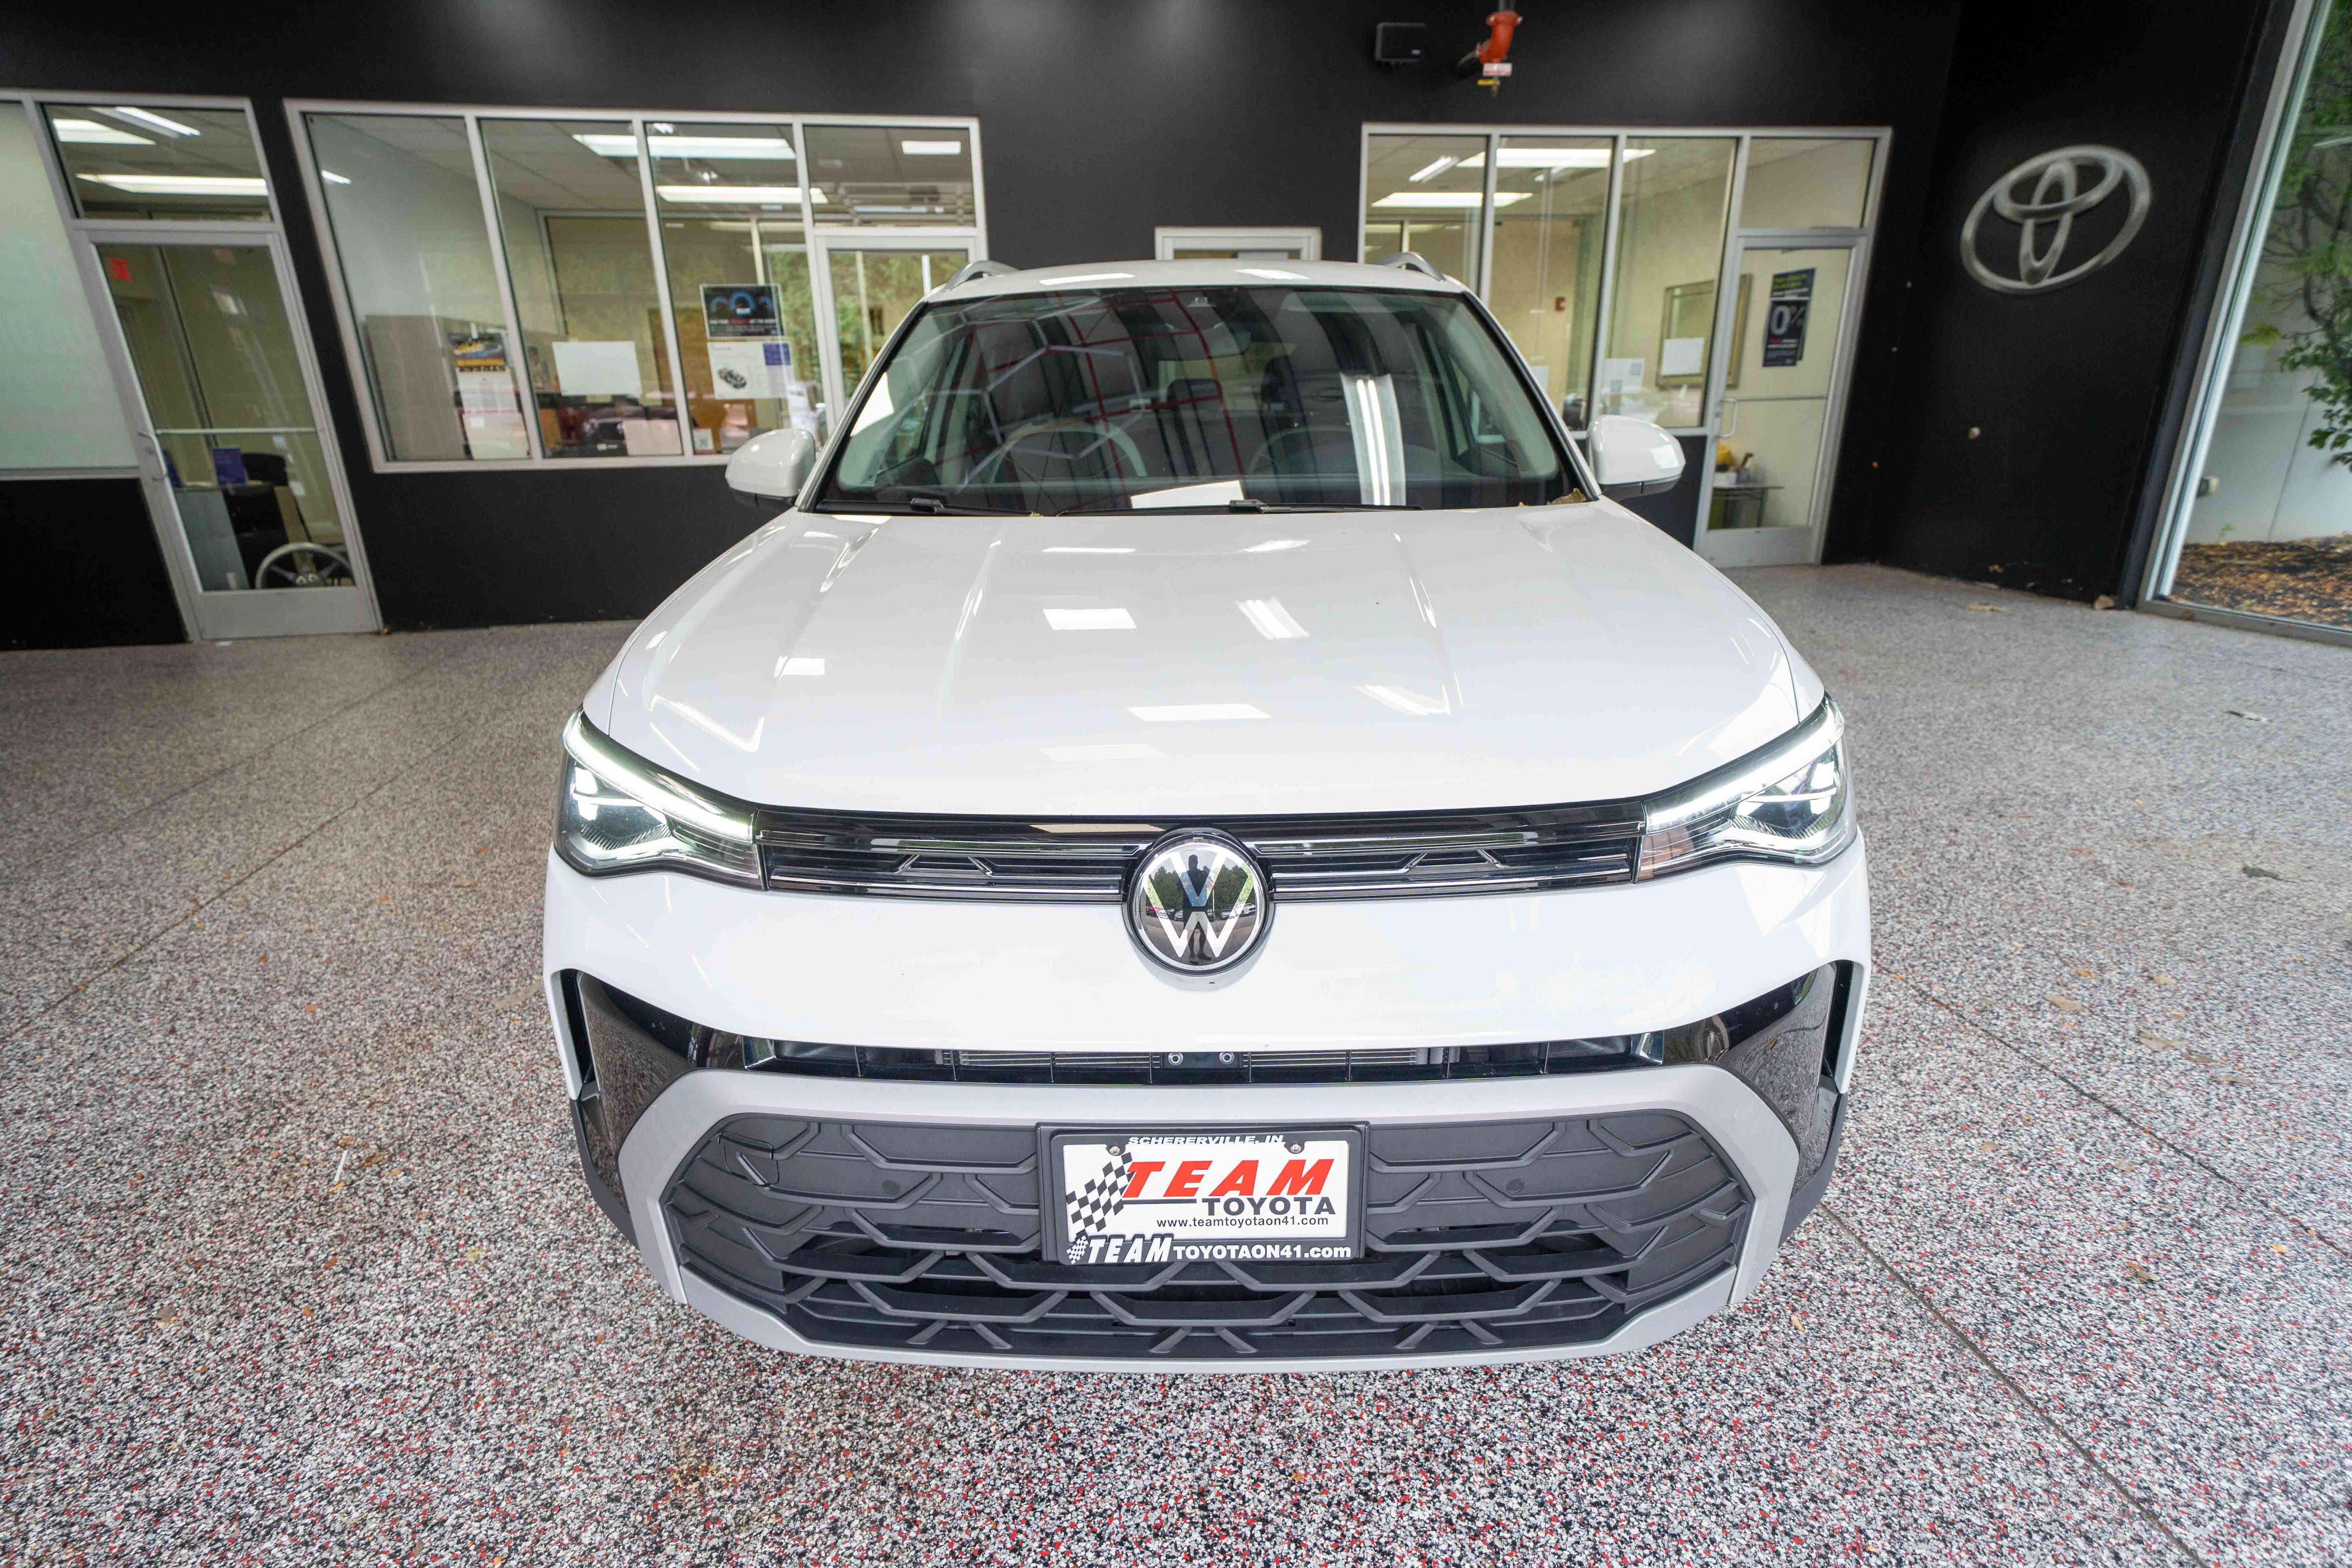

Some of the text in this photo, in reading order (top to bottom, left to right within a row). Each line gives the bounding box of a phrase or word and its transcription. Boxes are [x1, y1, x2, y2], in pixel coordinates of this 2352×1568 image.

[1265, 1134, 1284, 1144] IN
[1123, 1159, 1334, 1198] TEAM
[1202, 1197, 1336, 1216] TOYOTA
[1157, 1216, 1328, 1228] www.teamtoyotaon41.com
[1088, 1237, 1351, 1263] TEAM TOYOTAON41.com
